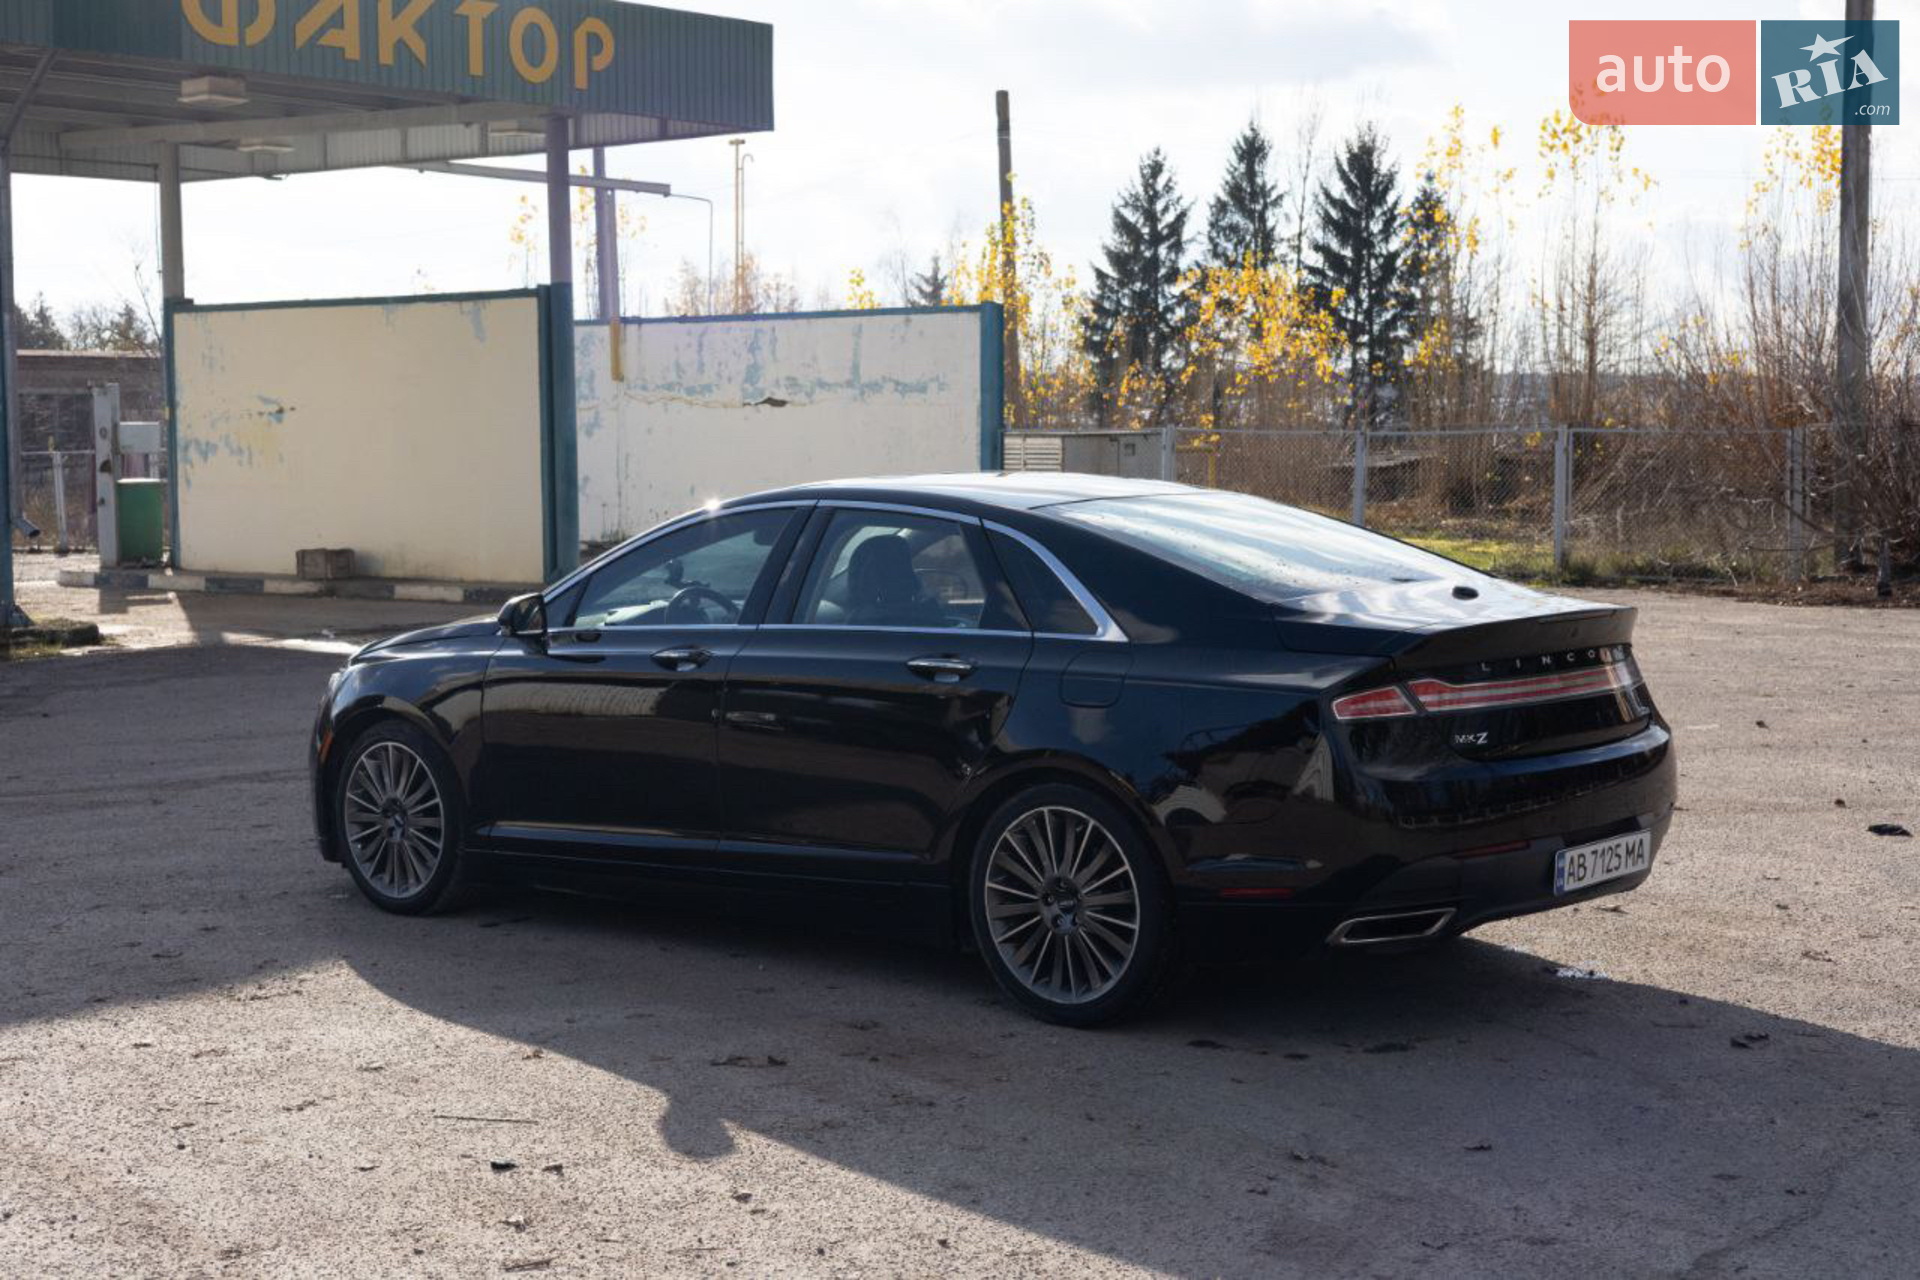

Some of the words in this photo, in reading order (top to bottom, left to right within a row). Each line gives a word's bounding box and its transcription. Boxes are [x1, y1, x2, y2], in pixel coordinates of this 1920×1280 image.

[1566, 853, 1587, 885] AB
[1590, 843, 1622, 878] 7125
[1625, 838, 1645, 869] MA
